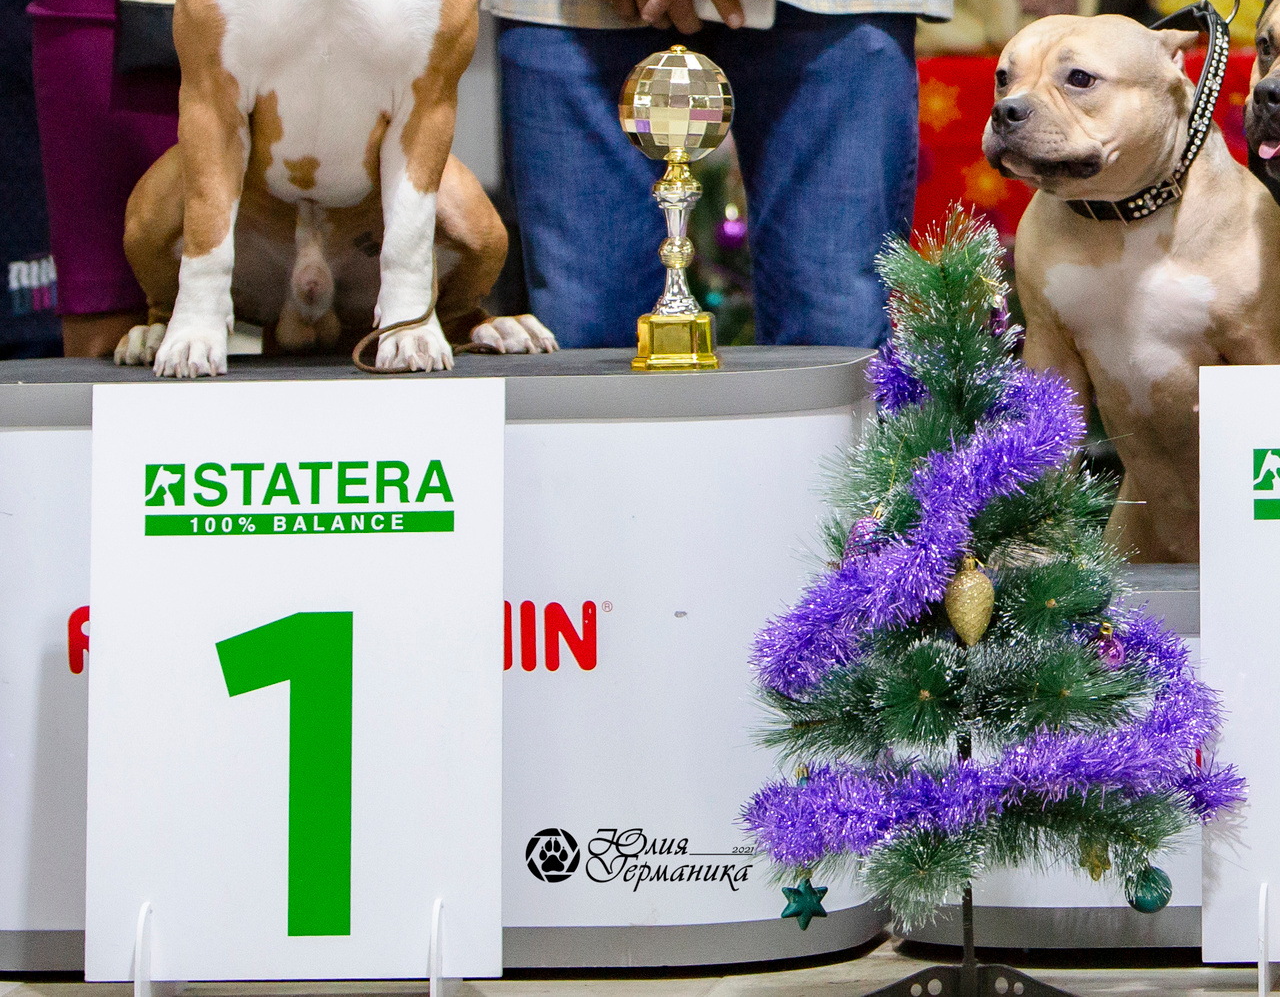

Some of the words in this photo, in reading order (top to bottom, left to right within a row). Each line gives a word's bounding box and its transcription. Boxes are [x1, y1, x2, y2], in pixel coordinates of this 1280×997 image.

[193, 460, 454, 507] STATERA
[190, 516, 256, 533] 100%
[273, 514, 404, 532] BALANCE
[215, 611, 354, 936] 1
